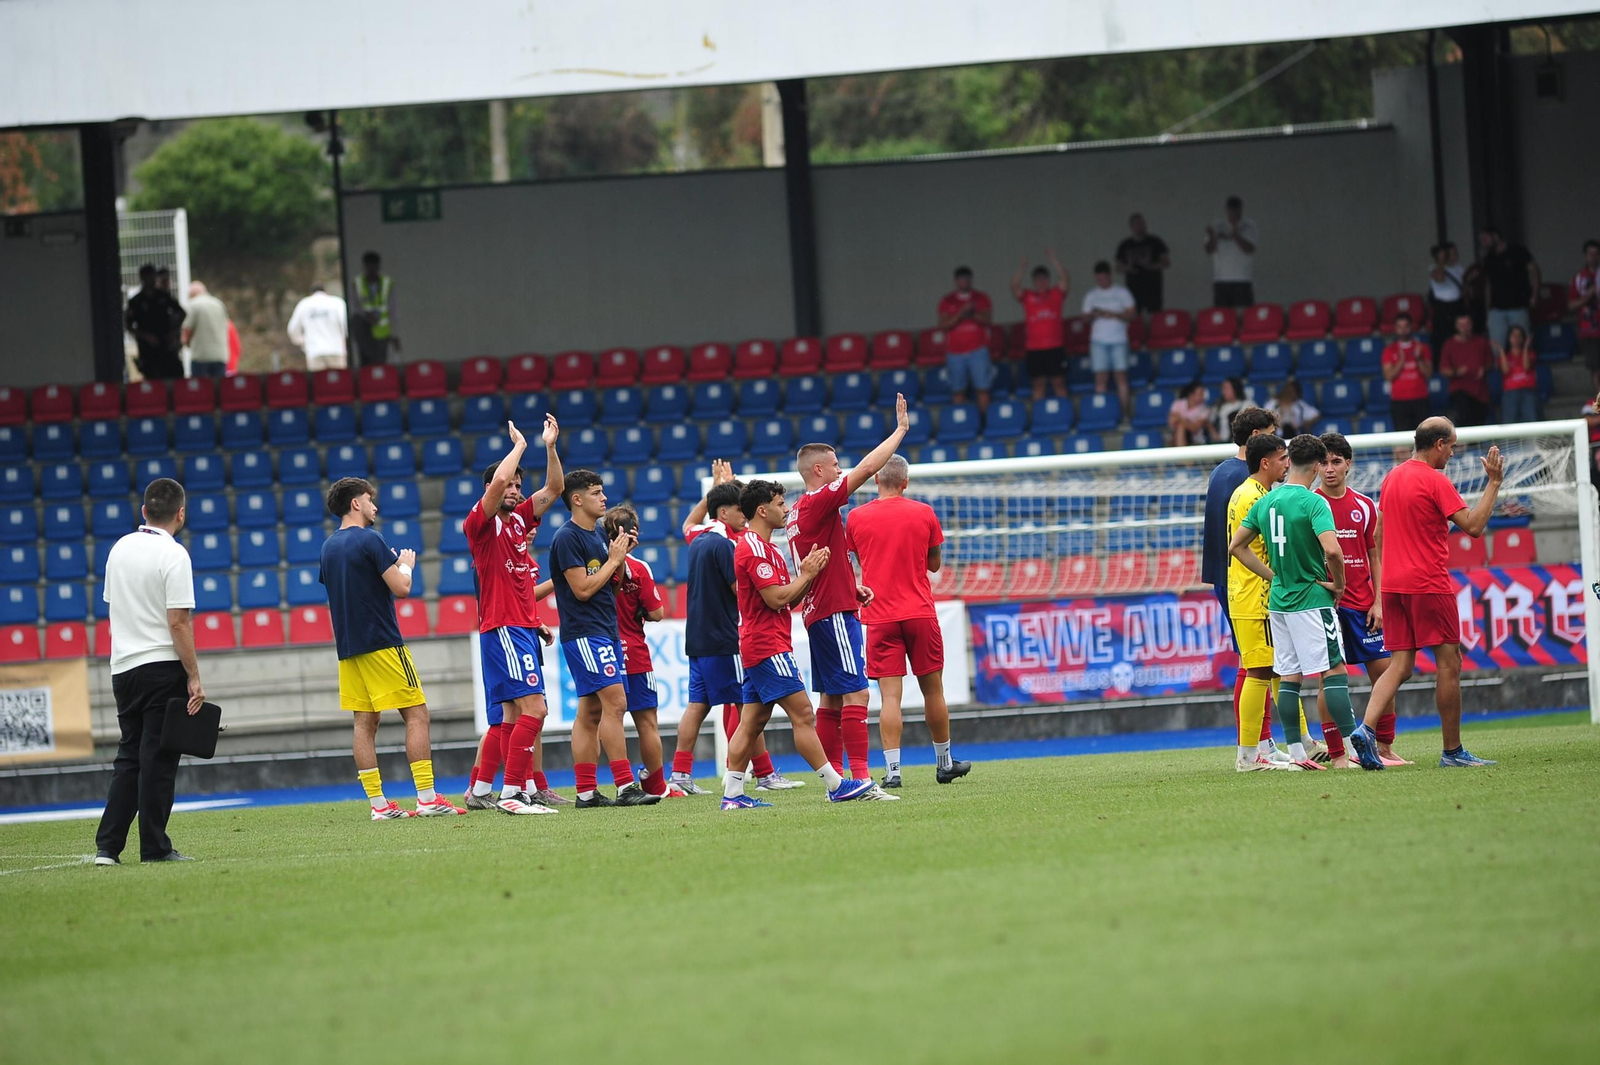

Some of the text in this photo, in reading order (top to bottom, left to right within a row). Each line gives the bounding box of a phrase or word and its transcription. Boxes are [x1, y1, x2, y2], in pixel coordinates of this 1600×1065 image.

[1269, 507, 1287, 557] 4
[522, 653, 534, 671] 8
[598, 645, 617, 664] 23
